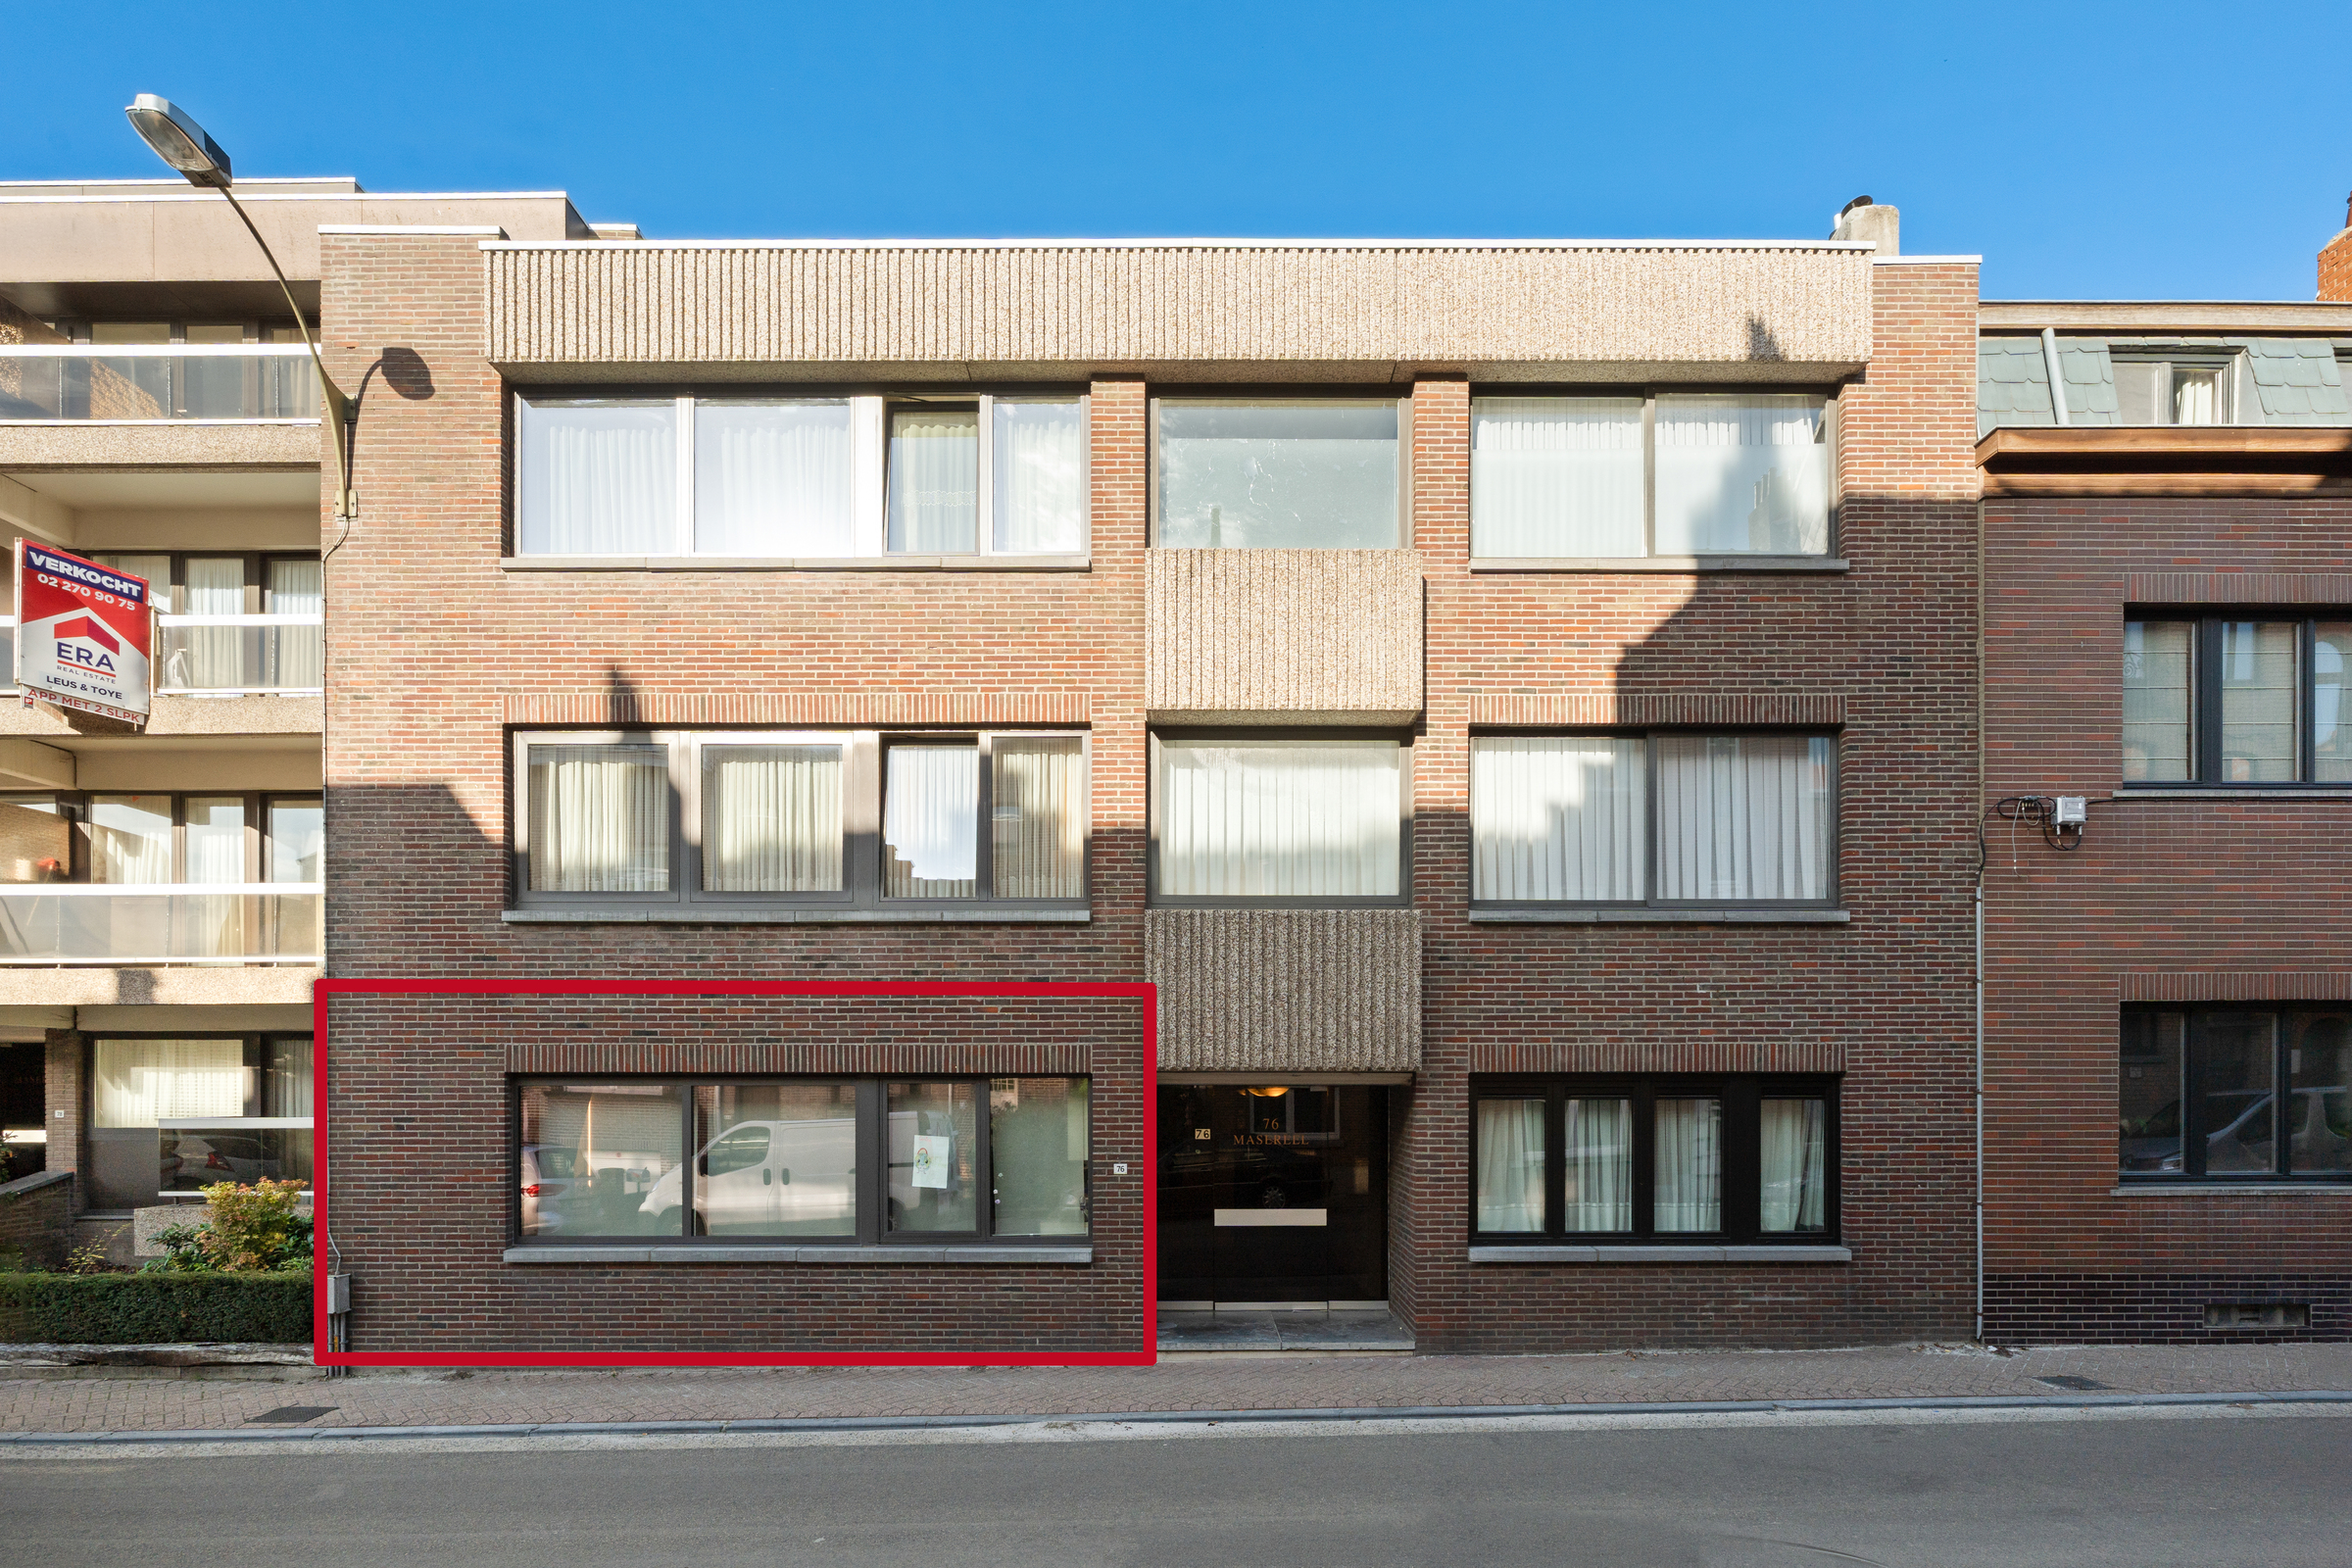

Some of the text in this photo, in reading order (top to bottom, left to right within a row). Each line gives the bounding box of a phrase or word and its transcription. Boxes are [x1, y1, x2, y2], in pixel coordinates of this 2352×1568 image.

[29, 551, 141, 597] VERKOCHT
[37, 573, 136, 611] 02 270 90 75
[57, 641, 116, 672] ERA
[57, 664, 117, 684] REAL ESTATE
[46, 675, 122, 700] LEUS & TOYE
[27, 689, 139, 723] APP MET 2 SLPK
[1196, 1129, 1210, 1139] 76
[1263, 1118, 1279, 1130] 76
[1233, 1134, 1309, 1146] MASEREEL
